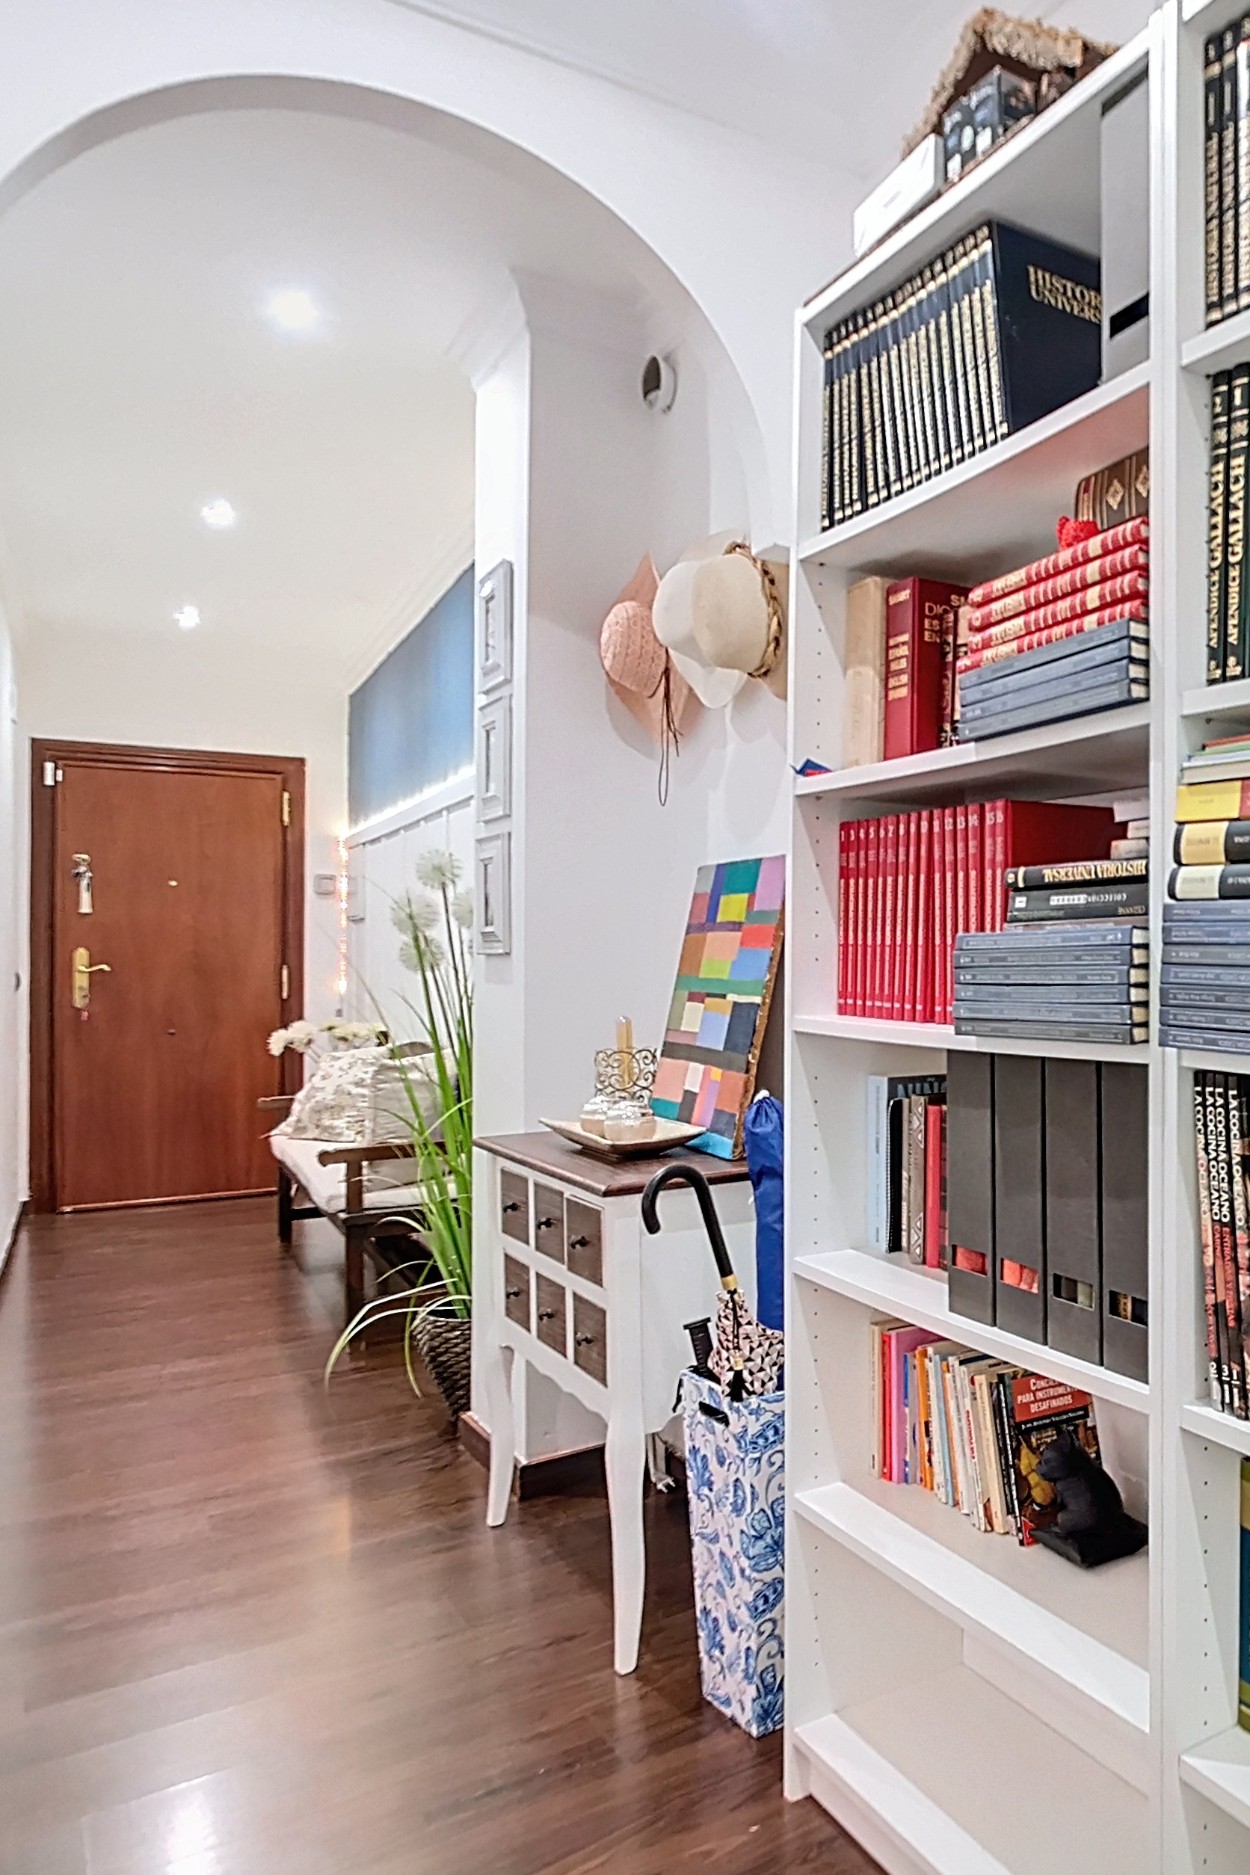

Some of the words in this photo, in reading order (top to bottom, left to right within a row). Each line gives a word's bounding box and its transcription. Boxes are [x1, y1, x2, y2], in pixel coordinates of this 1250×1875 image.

[1208, 462, 1224, 569] GALLACH
[1227, 455, 1246, 563] GALLACH
[1042, 864, 1096, 883] UNIVERSAL
[1097, 860, 1147, 879] HISTORIA
[1206, 1087, 1215, 1105] LA
[1215, 1088, 1224, 1106] LA
[1228, 1090, 1238, 1109] LA
[1206, 1107, 1216, 1159] COCINA
[1216, 1108, 1227, 1161] COCINA
[1230, 1110, 1242, 1164] COCINA
[1209, 1160, 1220, 1221] OCEANO
[1219, 1162, 1230, 1223] OCEANO
[1017, 1392, 1035, 1405] PARA
[1030, 1394, 1072, 1413] DESAFINADOS
